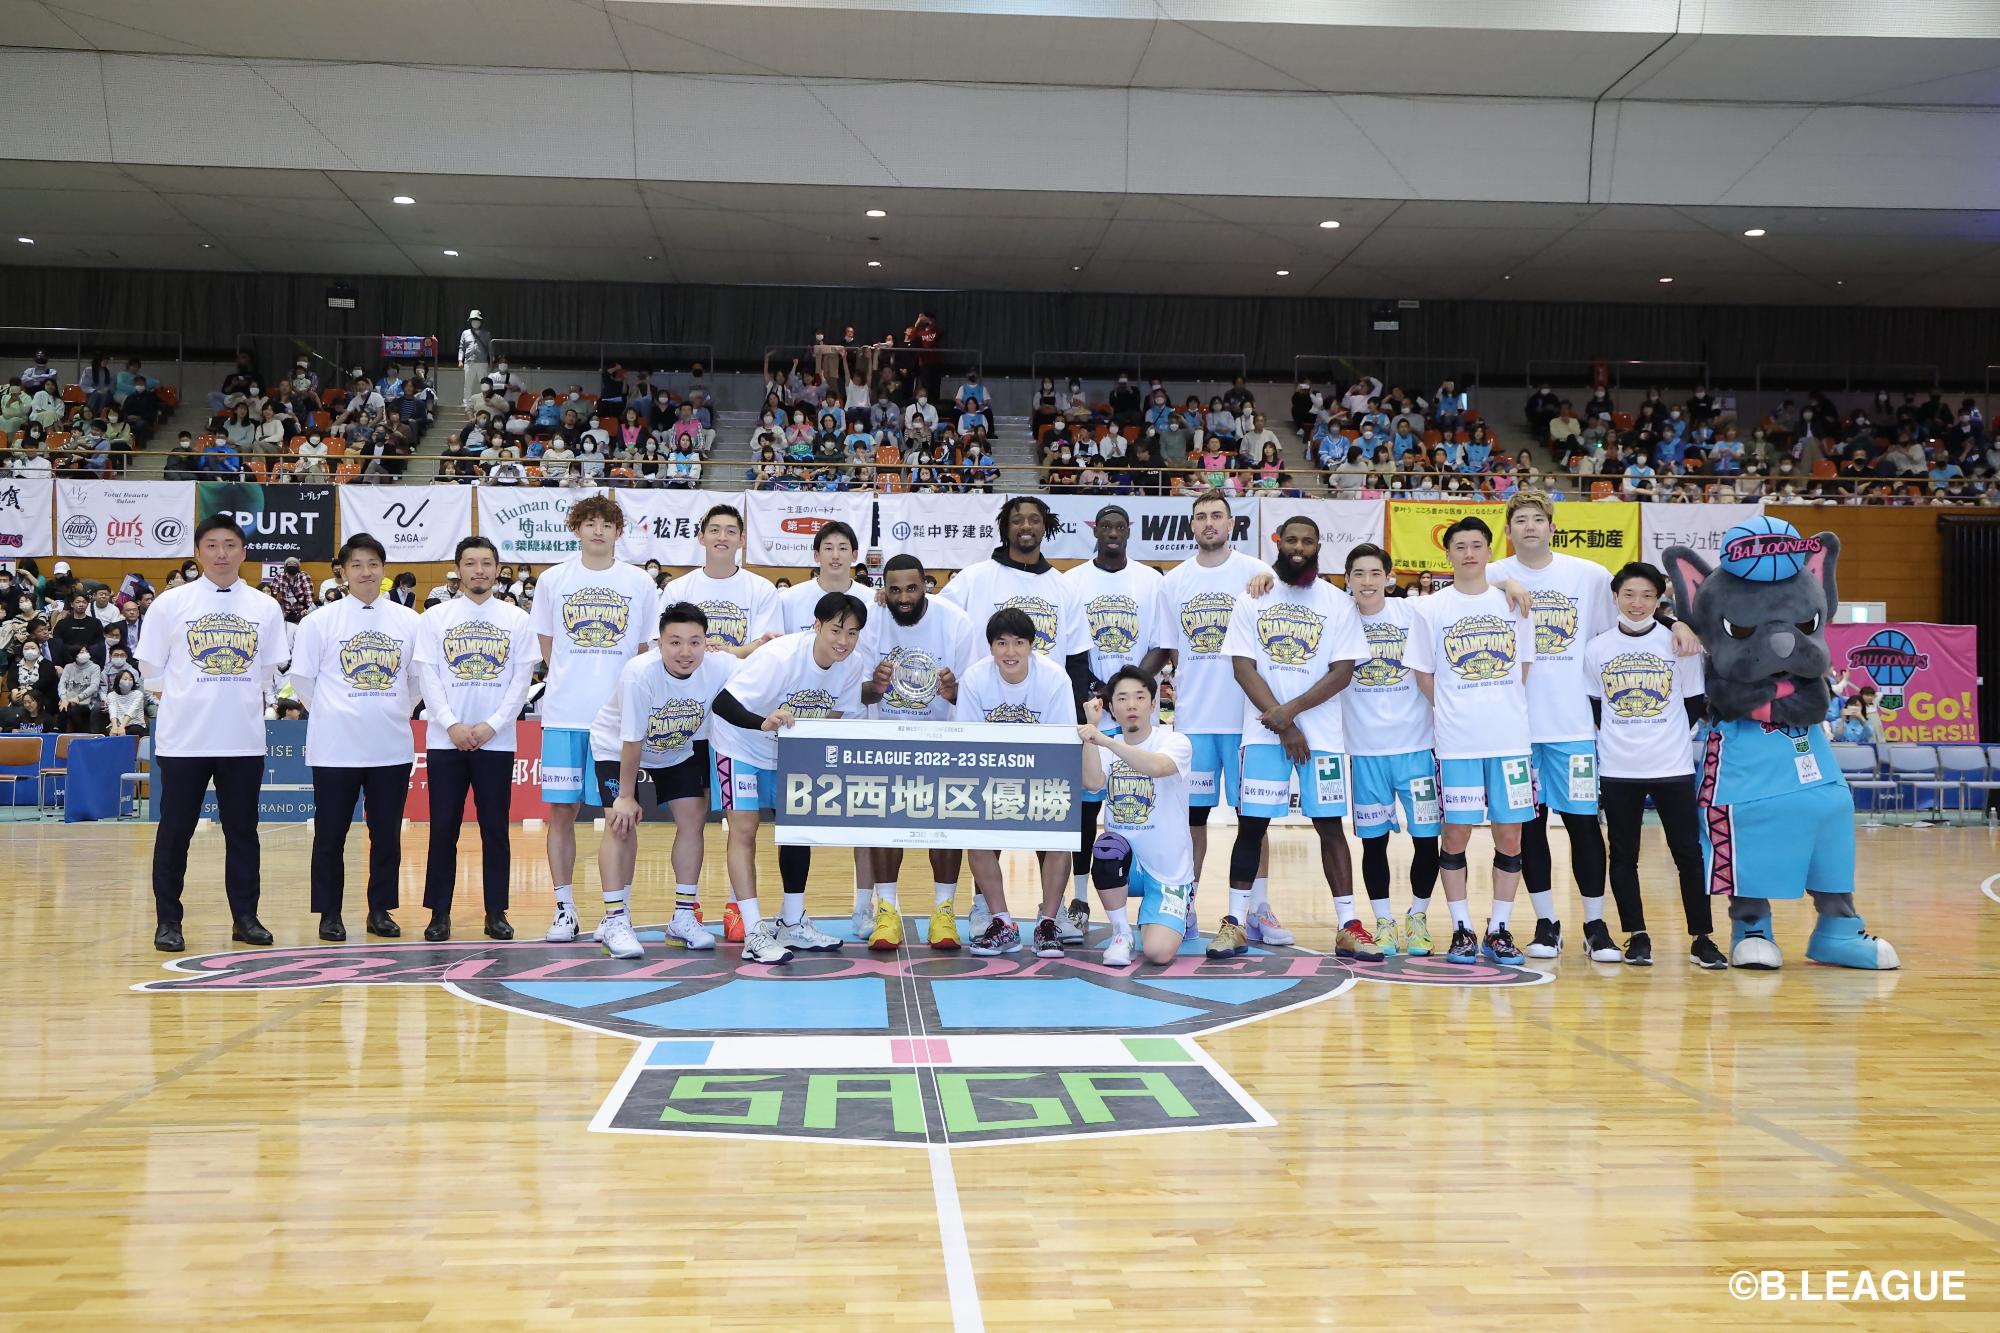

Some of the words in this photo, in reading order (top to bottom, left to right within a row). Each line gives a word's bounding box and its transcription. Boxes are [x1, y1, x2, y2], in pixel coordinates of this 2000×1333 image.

[494, 499, 550, 526] Human
[778, 505, 842, 514] 一生涯のパートナー
[108, 521, 143, 537] CUTS
[394, 533, 419, 543] SAGA
[787, 521, 828, 533] 第一生
[928, 524, 994, 539] 中野建設
[1141, 515, 1250, 541] WINR
[1550, 529, 1624, 549] 前不動産
[244, 542, 301, 551] たも挑むために。
[775, 542, 808, 551] Dai-ichi
[1730, 537, 1822, 562] BALLOONERS
[563, 602, 629, 632] CHAMPIONS
[187, 630, 258, 658] CHAMPIONS
[706, 617, 748, 646] MPIONS
[1257, 619, 1324, 652] CHAMPIONS
[443, 637, 510, 665] CHAMPIONS
[1444, 630, 1516, 664] CHAMPIONS
[340, 648, 401, 676] CHAMPIONS
[1850, 652, 1929, 669] BALLOONERS
[1601, 670, 1674, 699] CHAMPIONS
[1908, 691, 1973, 722] Go!
[1883, 724, 1976, 743] ONERS!!
[843, 749, 911, 766] B.LEAGUE
[914, 752, 977, 767] 2022-23
[979, 753, 1035, 769] SEASON
[298, 803, 317, 813] OP
[785, 773, 1072, 822] B2西地区優勝
[659, 1069, 1200, 1133] SAGA
